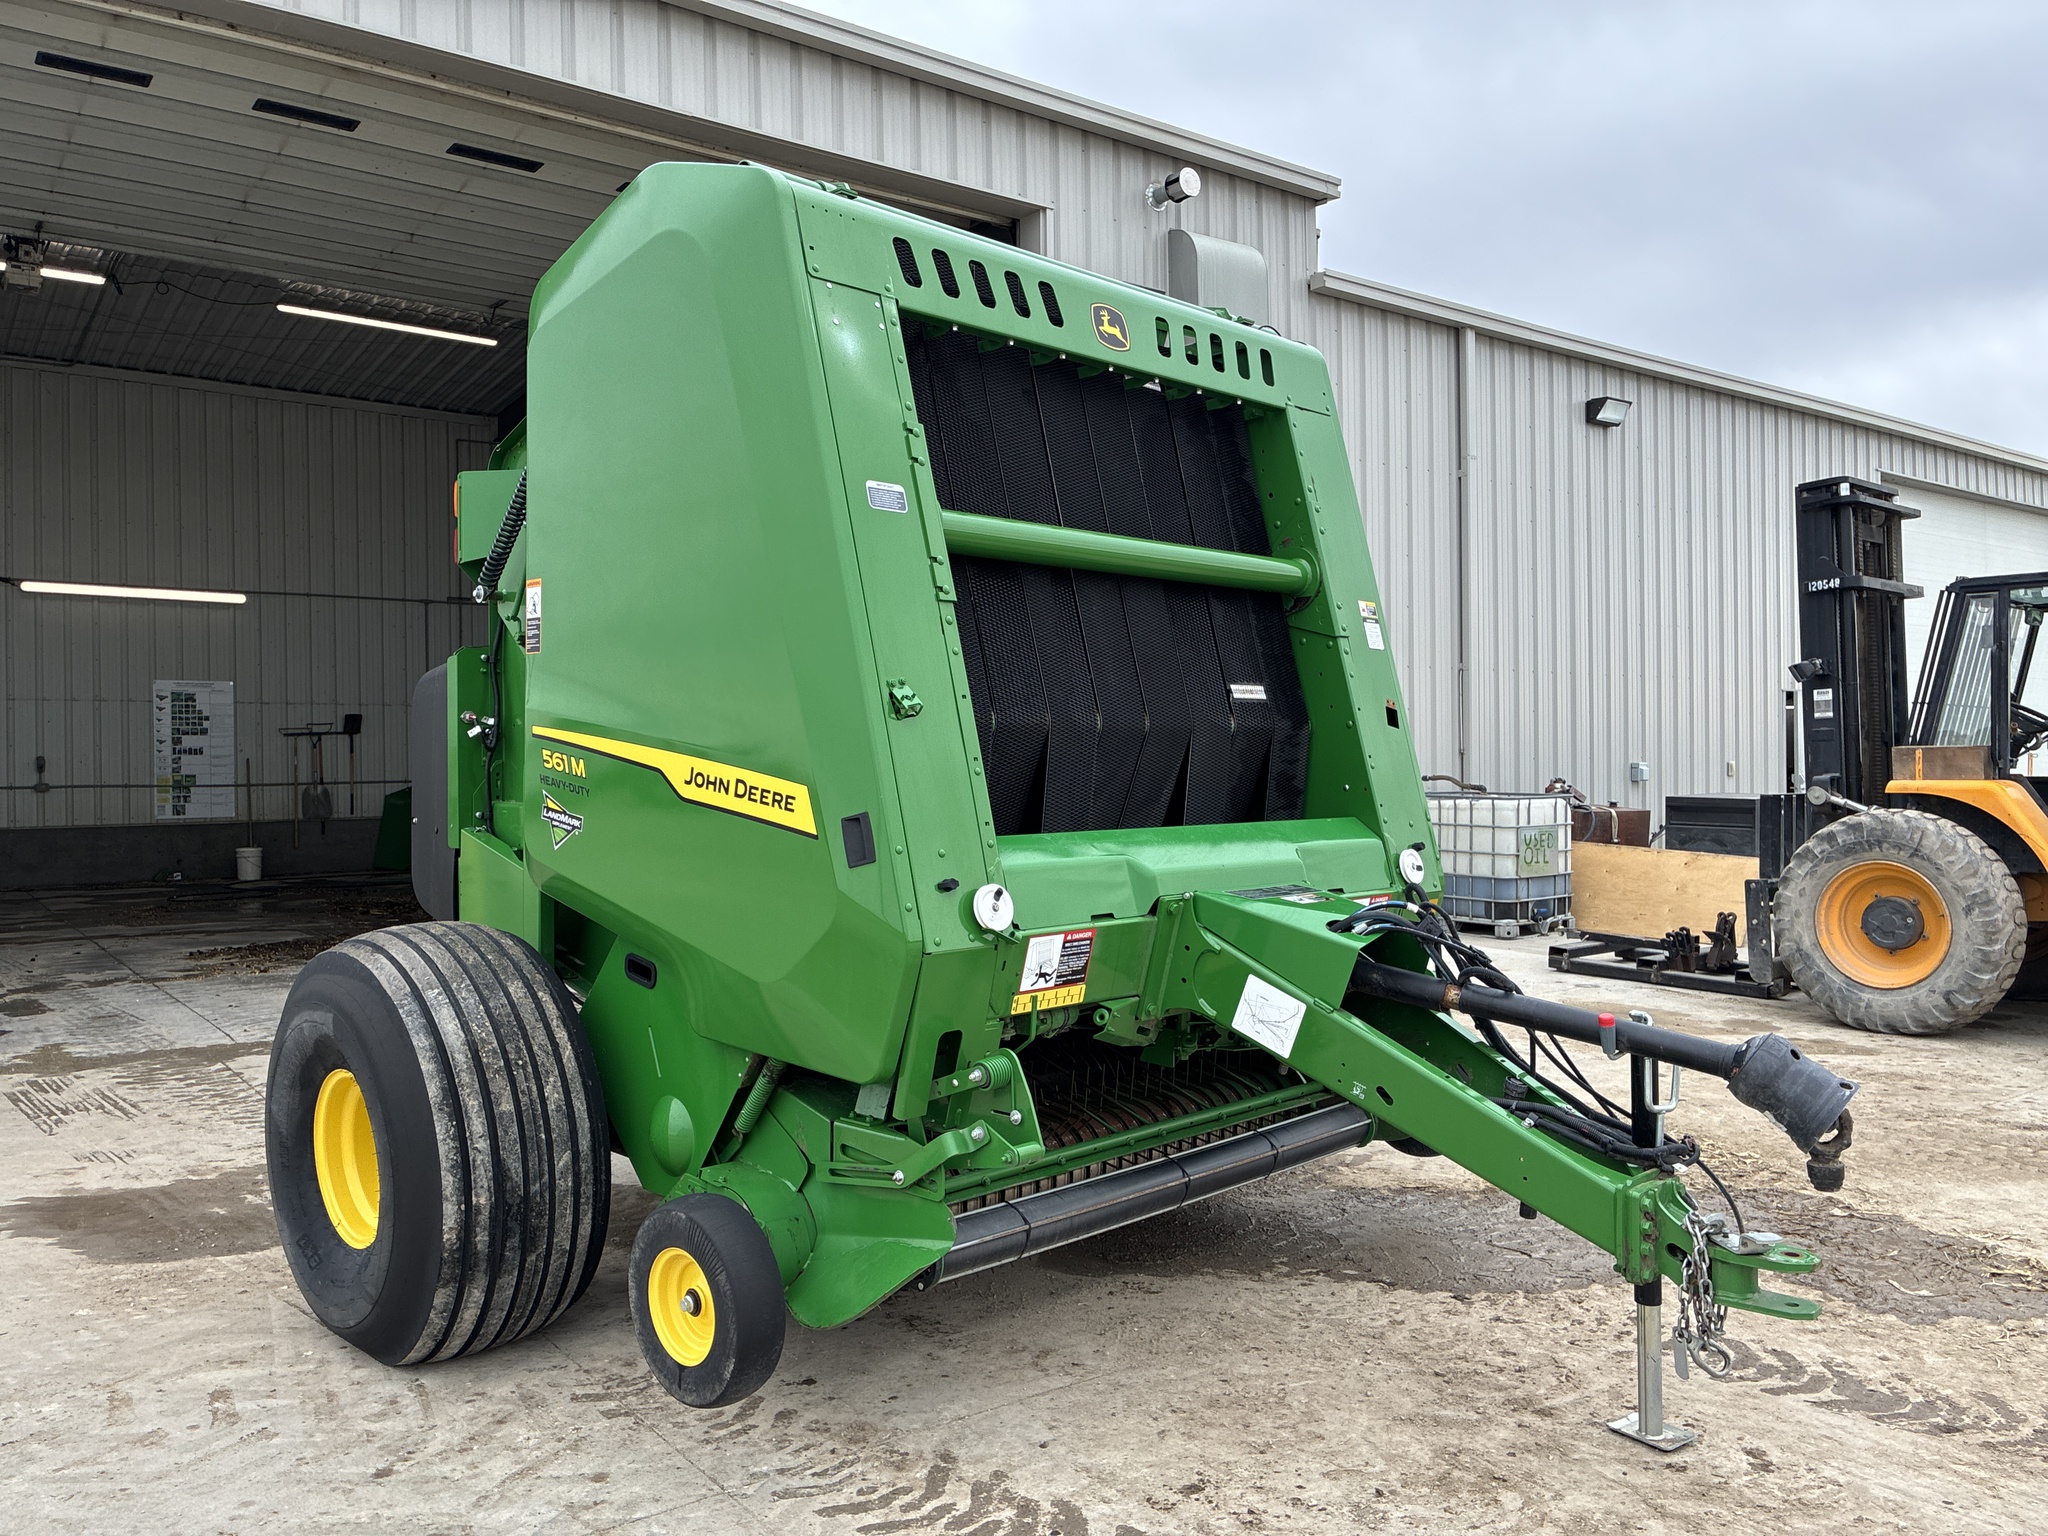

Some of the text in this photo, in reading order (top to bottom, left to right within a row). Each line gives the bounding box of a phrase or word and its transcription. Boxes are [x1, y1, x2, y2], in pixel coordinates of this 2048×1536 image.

[1808, 578, 1840, 592] 120548
[539, 774, 590, 797] HEAVY-DUTY
[684, 766, 796, 813] JOHN DEERE
[1523, 832, 1554, 849] USED
[1523, 846, 1550, 865] OIL
